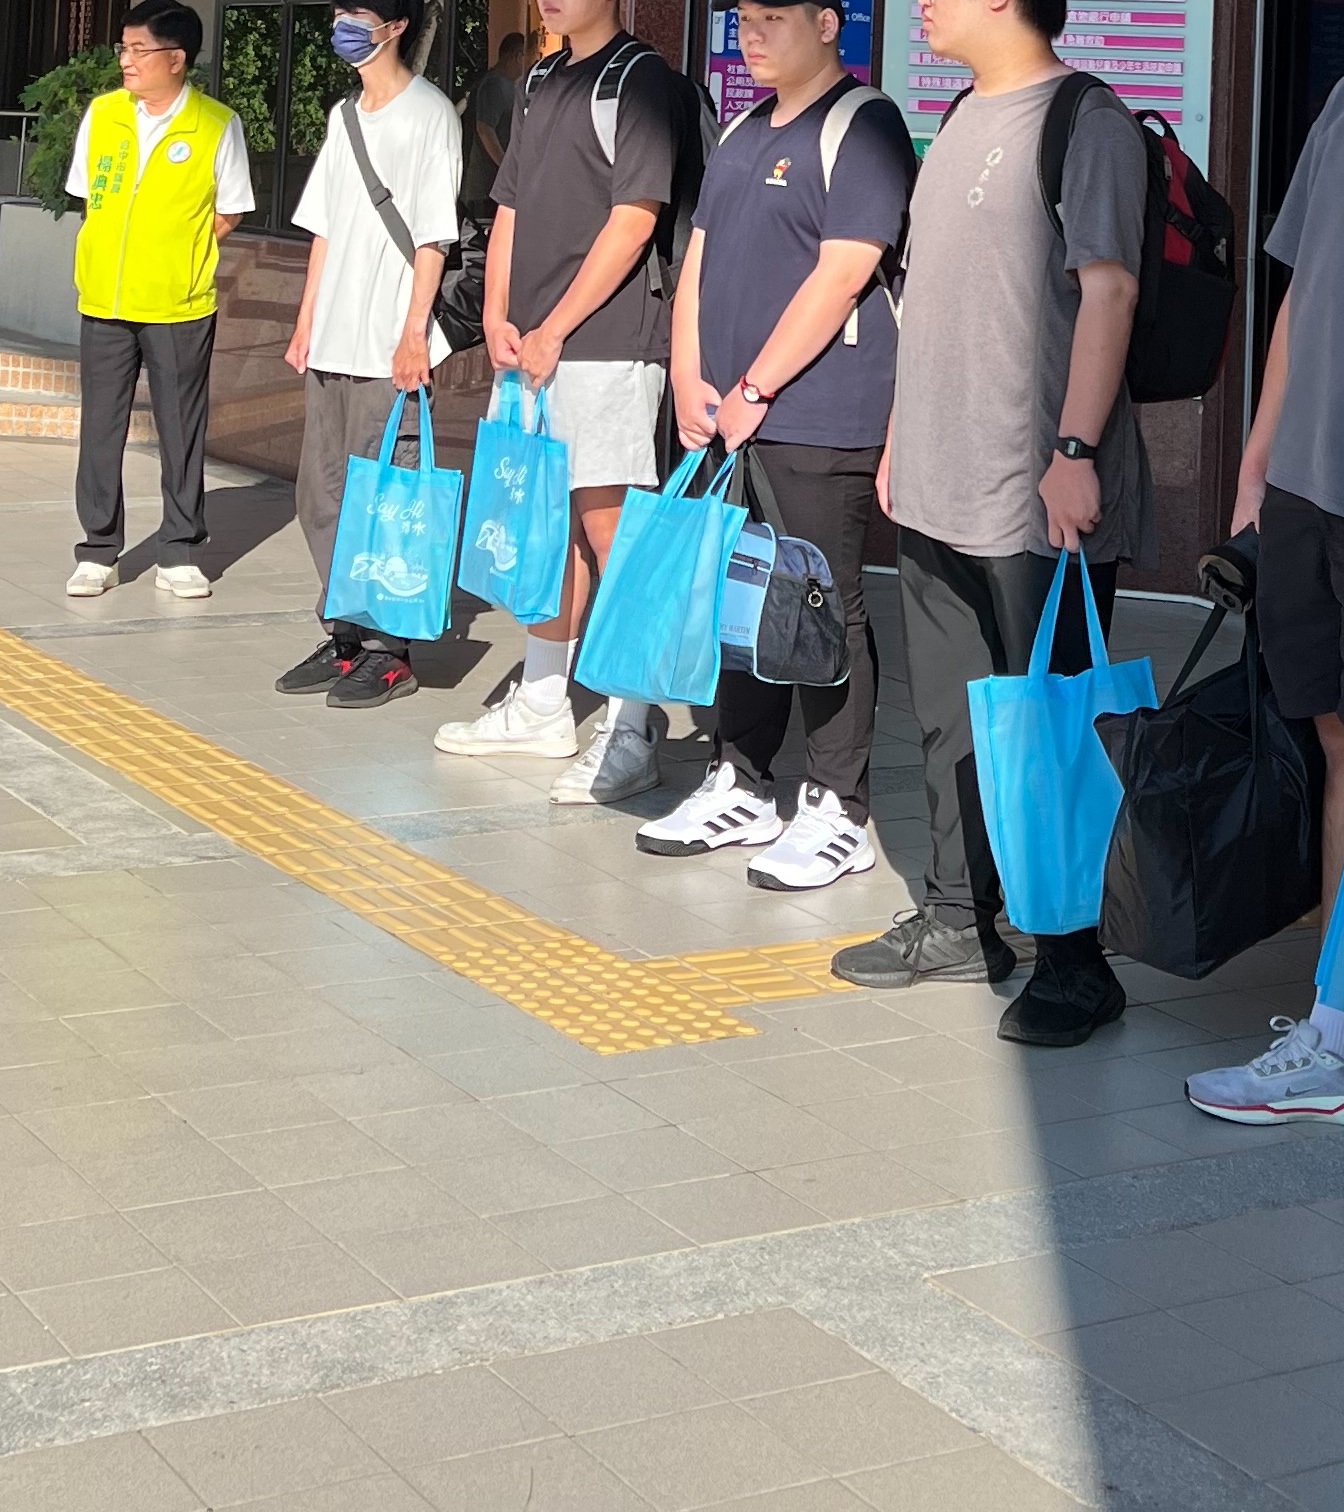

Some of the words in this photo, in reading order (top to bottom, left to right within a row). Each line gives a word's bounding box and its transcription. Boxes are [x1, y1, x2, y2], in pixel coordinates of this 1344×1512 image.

[851, 13, 871, 23] Office
[366, 492, 399, 521] Say
[399, 498, 425, 520] Hi
